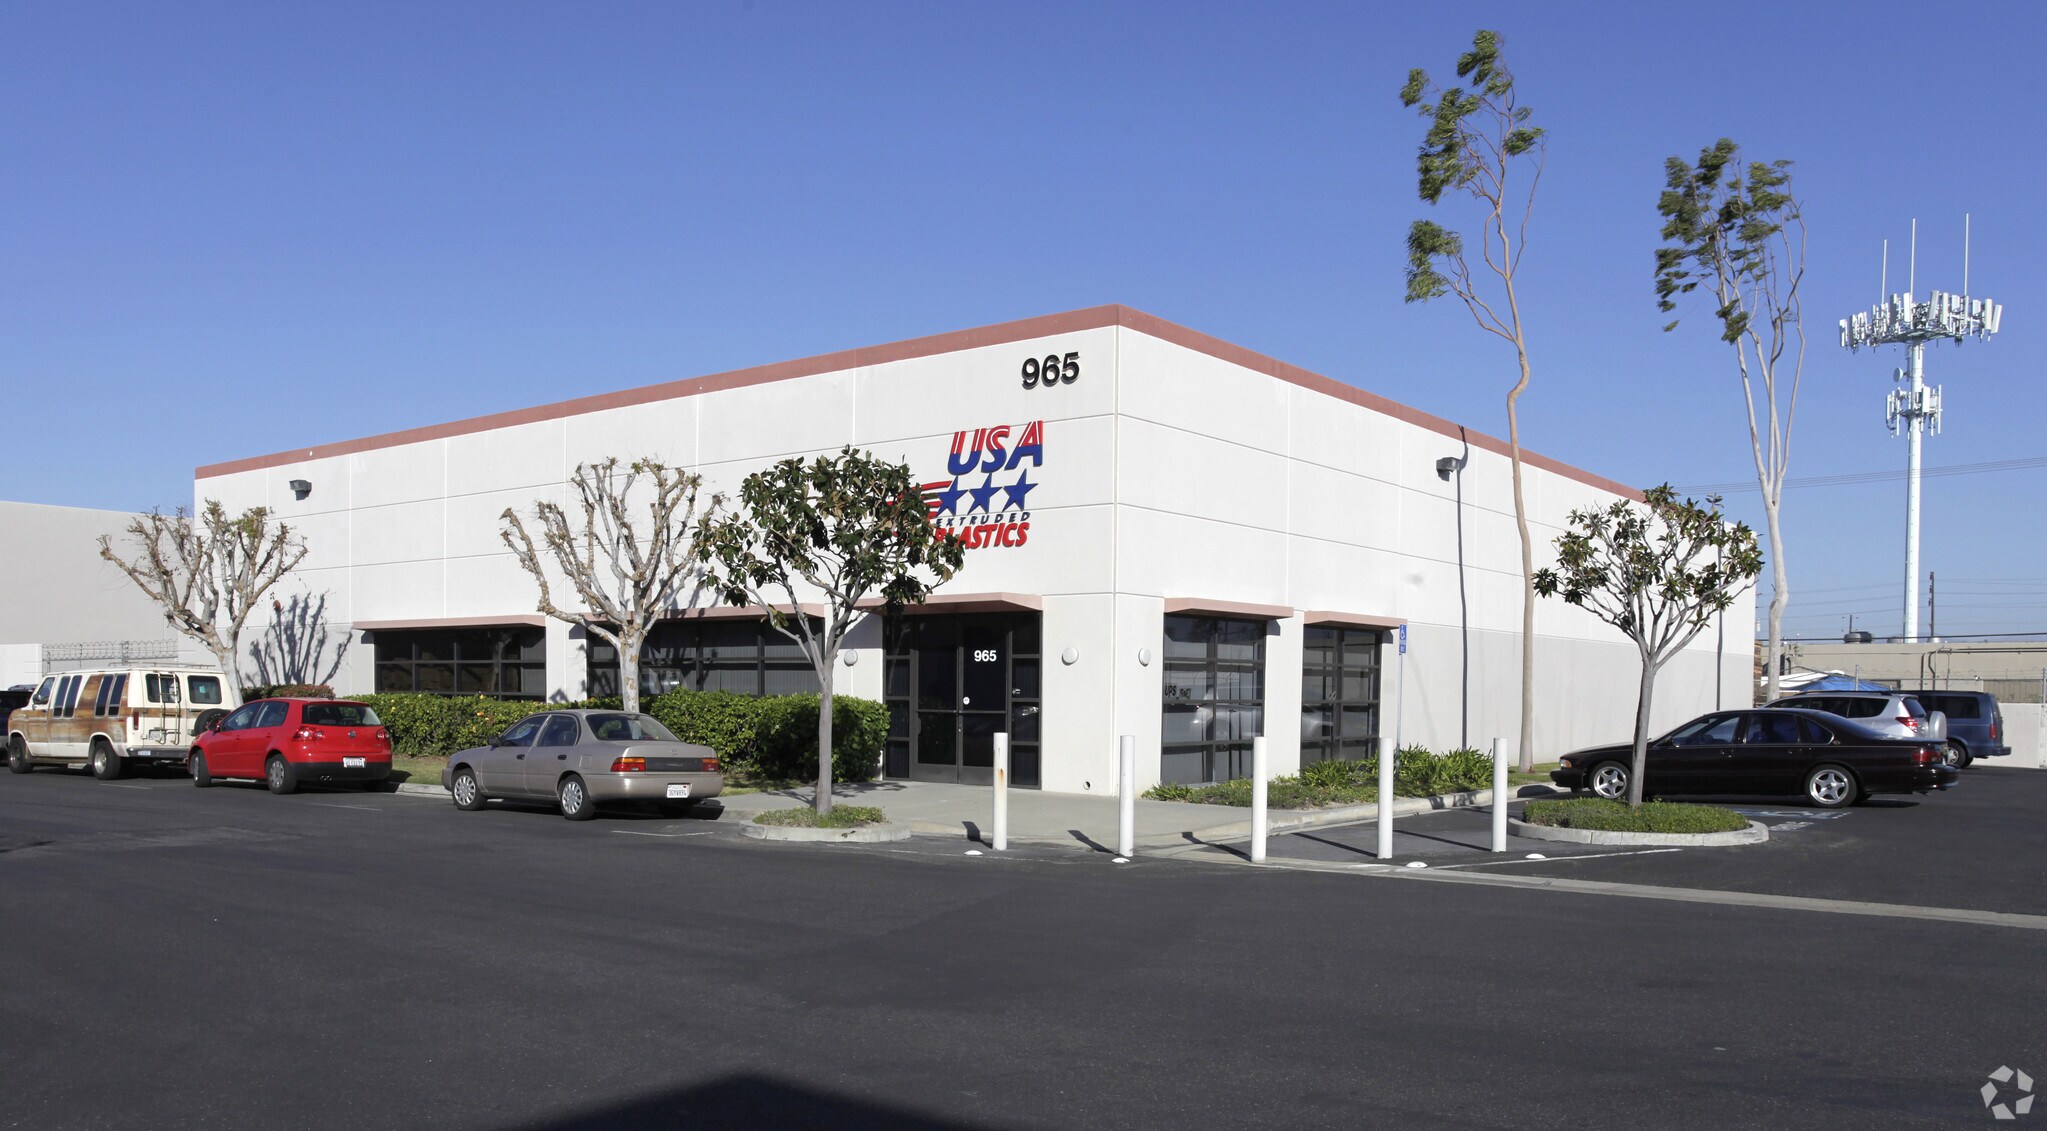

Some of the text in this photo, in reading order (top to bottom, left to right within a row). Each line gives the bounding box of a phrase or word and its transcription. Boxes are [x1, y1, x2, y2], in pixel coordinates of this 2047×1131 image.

[1022, 352, 1080, 390] 965
[947, 420, 1043, 476] USA
[936, 511, 1031, 527] EXTRUDED
[974, 649, 997, 662] 965
